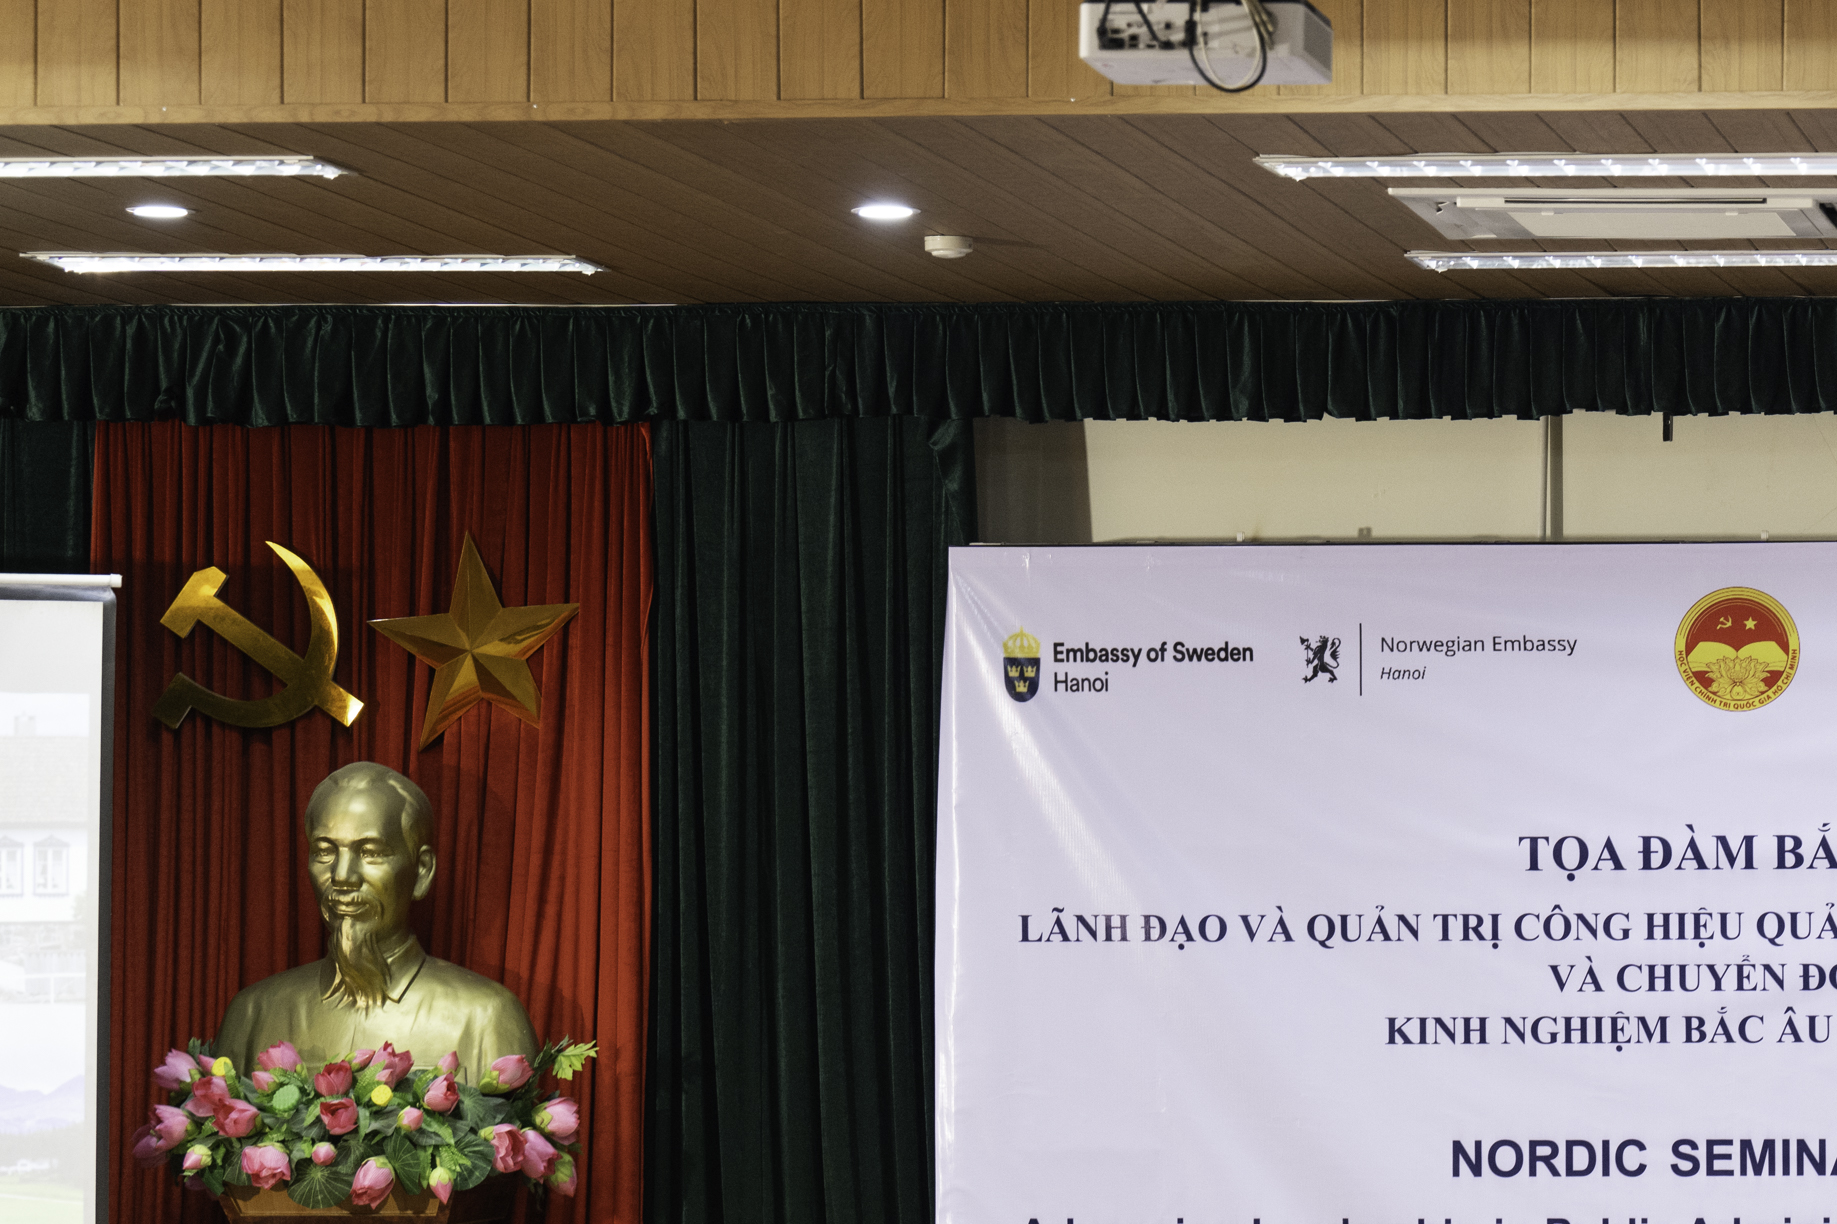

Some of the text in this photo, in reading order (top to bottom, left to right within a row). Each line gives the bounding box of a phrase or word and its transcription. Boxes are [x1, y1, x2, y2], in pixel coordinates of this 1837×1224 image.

[1053, 641, 1254, 668] Embassy of Sweden
[1380, 634, 1578, 657] Norwegian Embassy
[1053, 671, 1109, 693] Hanoi
[1380, 665, 1427, 681] Hanoi
[1518, 835, 1626, 882] TỌA
[1637, 823, 1758, 870] ĐÀM
[1019, 906, 1129, 943] LÃNH
[1140, 914, 1228, 951] ĐẠO
[1238, 905, 1295, 943] VÀ
[1306, 904, 1422, 950] QUẢN
[1432, 913, 1502, 950] TRỊ
[1513, 904, 1632, 942] CÔNG
[1644, 907, 1743, 949] HIỆU
[1547, 955, 1605, 993] VÀ
[1616, 954, 1787, 993] CHUYỂN
[1385, 1015, 1490, 1045] KINH
[1501, 1010, 1670, 1053] NGHIỆM
[1682, 1006, 1764, 1044] BẮC
[1776, 1006, 1832, 1044] ÂU
[1452, 1138, 1648, 1178] NORDIC
